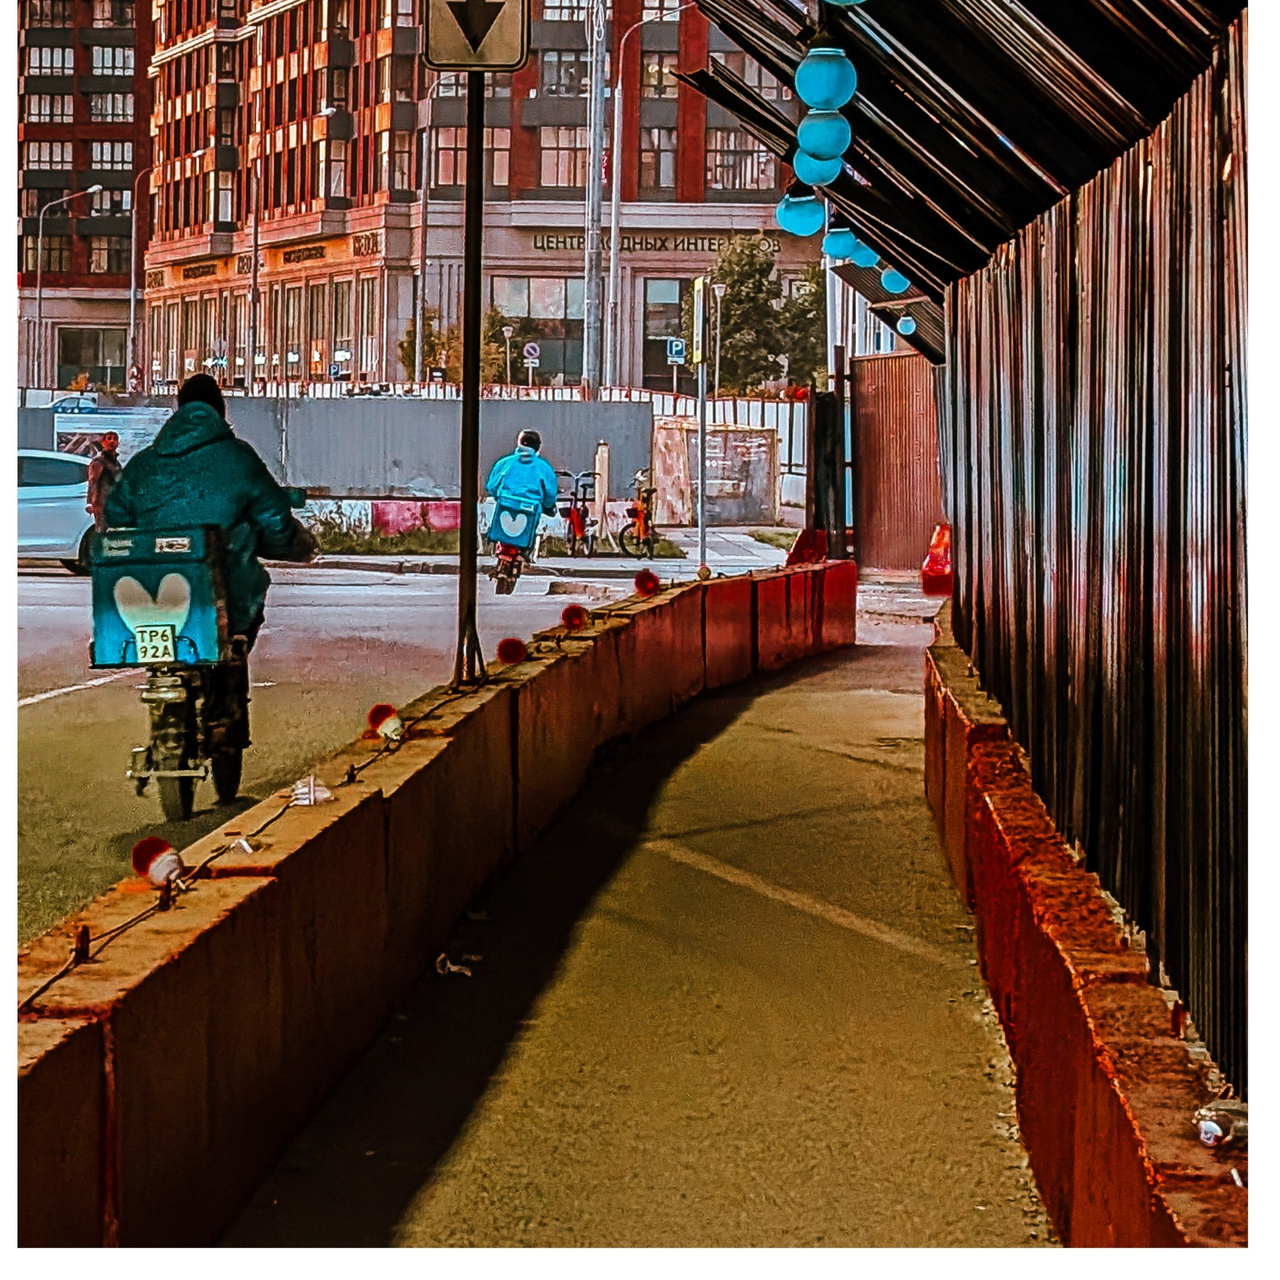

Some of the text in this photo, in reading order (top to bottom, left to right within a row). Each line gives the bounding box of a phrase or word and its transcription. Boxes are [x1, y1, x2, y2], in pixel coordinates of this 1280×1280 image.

[600, 235, 669, 253] ДНЫХ
[136, 629, 170, 643] ТР6
[139, 645, 172, 659] 92А
